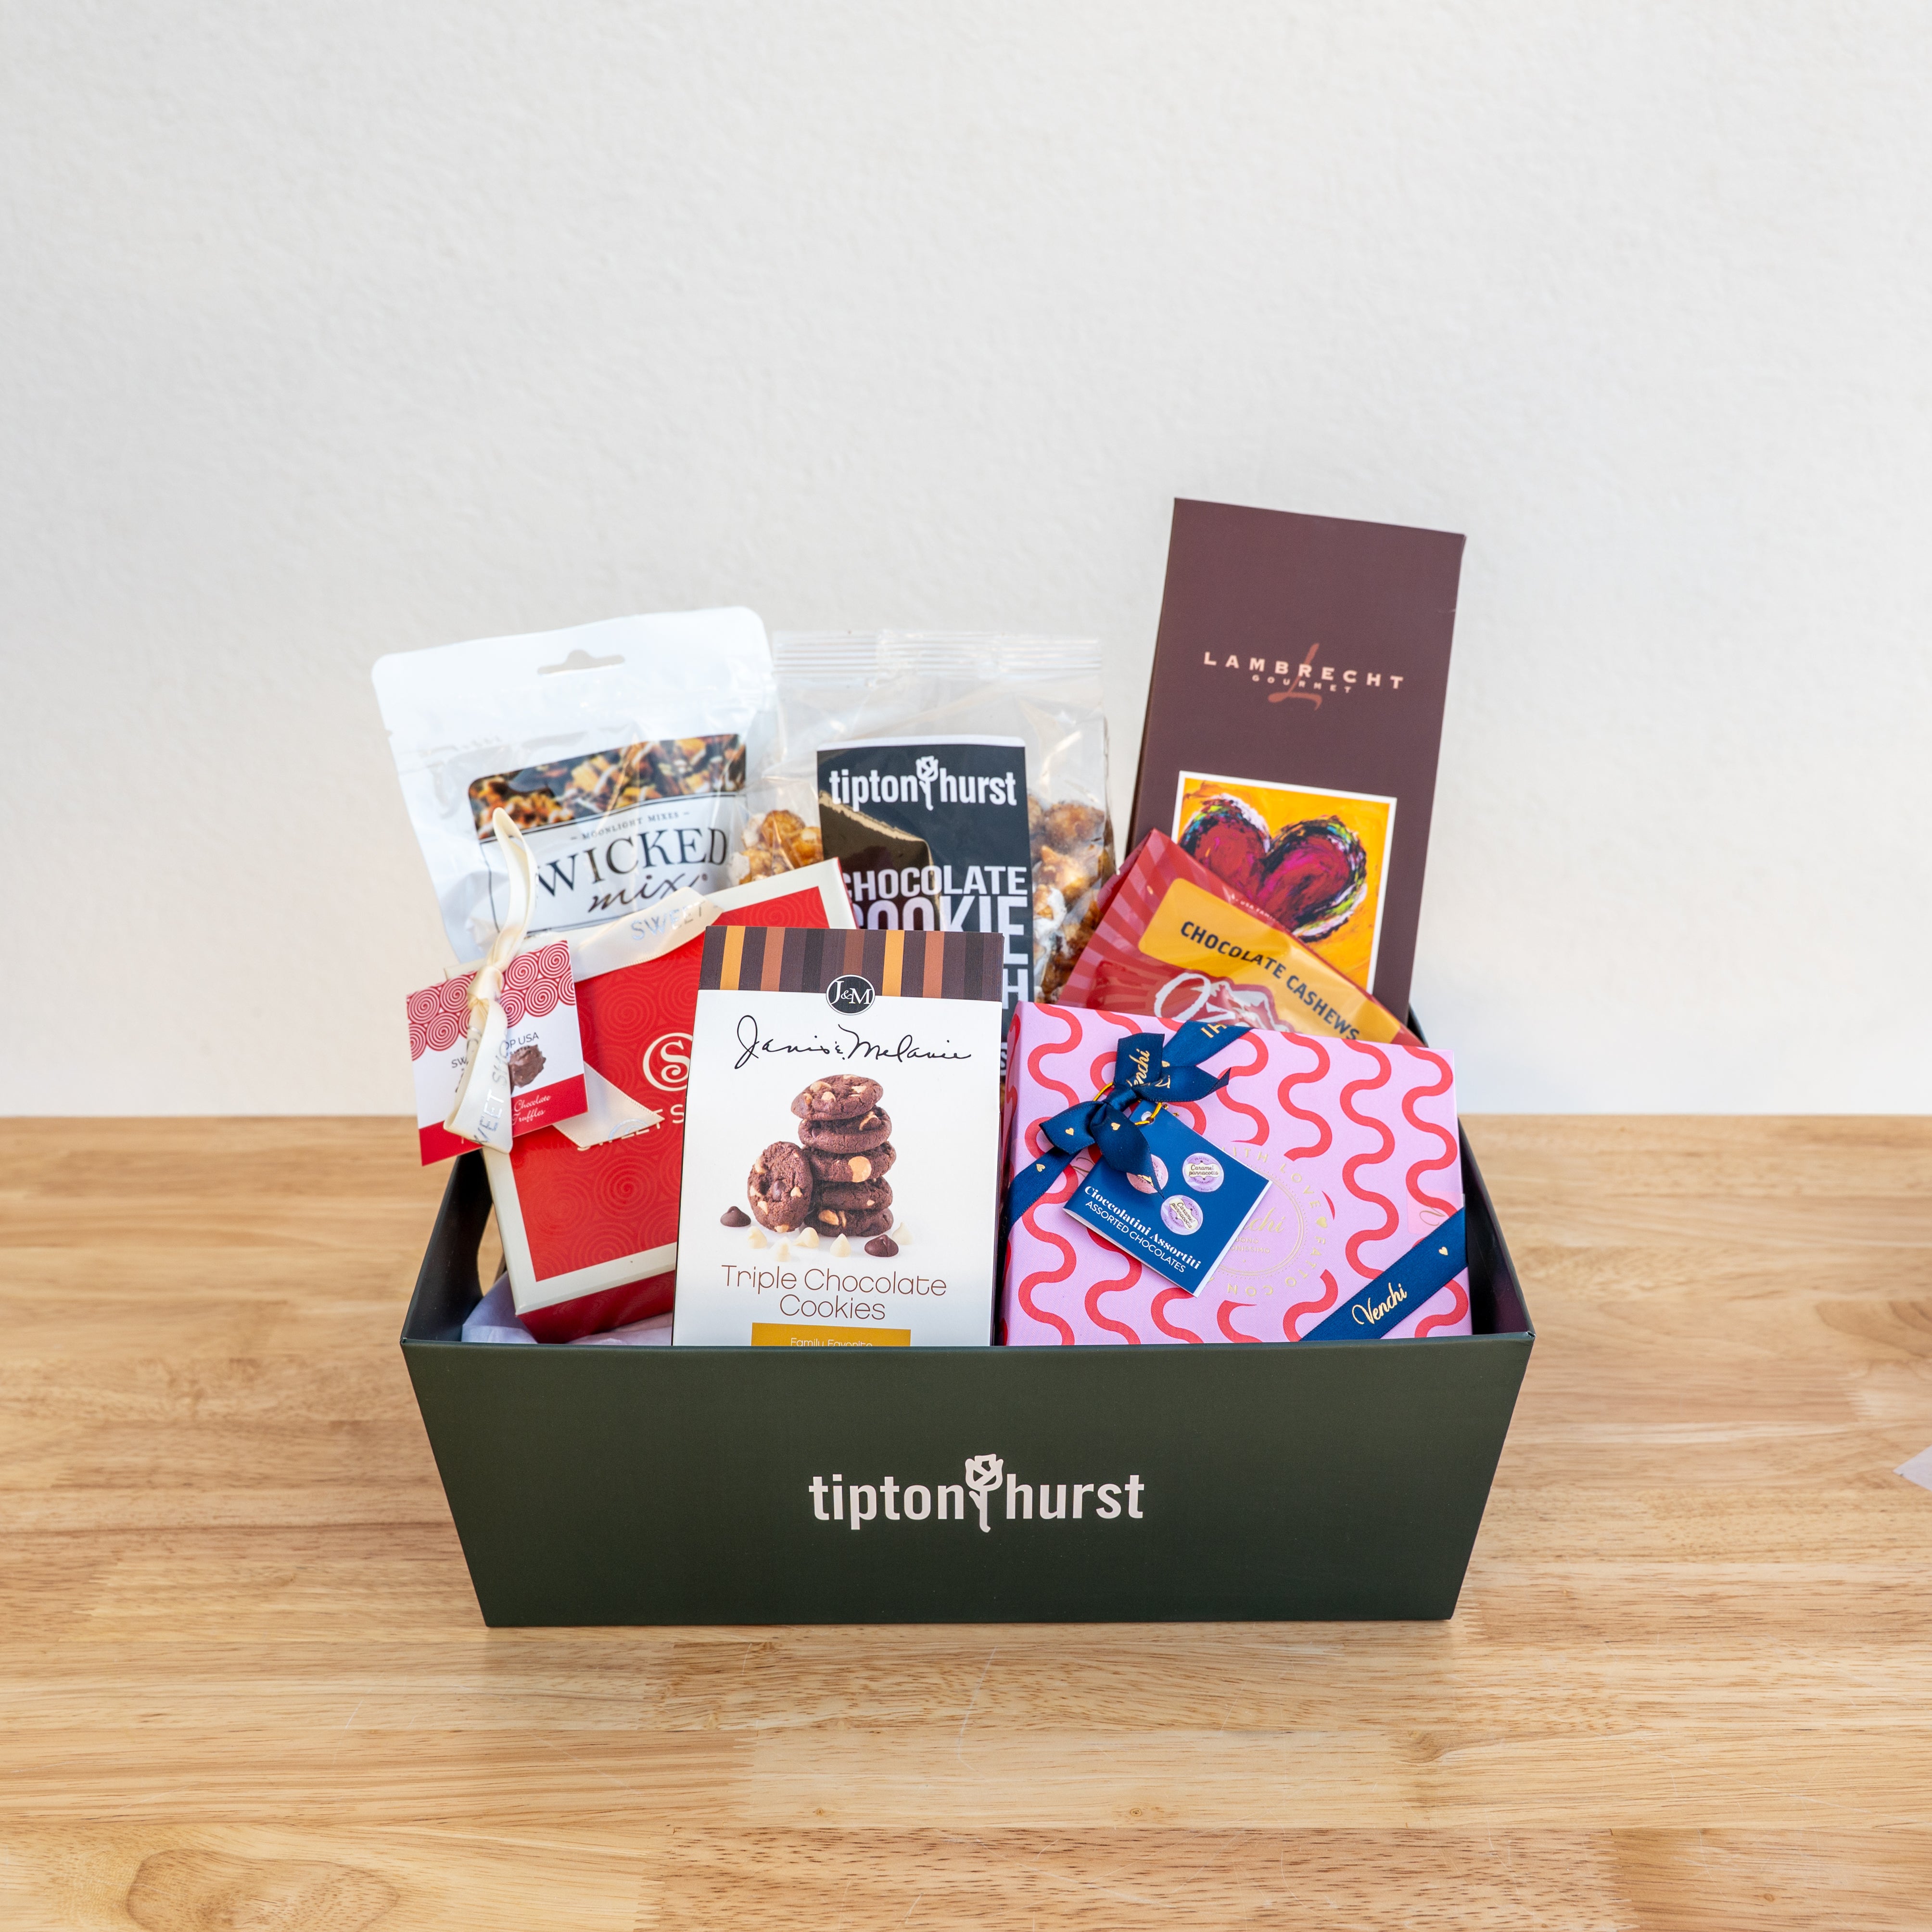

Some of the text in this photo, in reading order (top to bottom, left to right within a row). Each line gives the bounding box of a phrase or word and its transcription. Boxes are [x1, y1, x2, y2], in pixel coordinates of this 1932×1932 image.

[1204, 651, 1403, 689] LAMBRECHT
[1252, 674, 1351, 693] GOURMET
[829, 768, 1017, 812] tipton hurst
[582, 812, 679, 839] MOONLIGHT MIXES
[537, 827, 727, 897] WICKED
[630, 901, 705, 940] SWEET
[1180, 921, 1360, 1040] CHOCOLATE CASHEWS
[519, 1032, 539, 1045] USA
[735, 1015, 830, 1069] Janis
[838, 1024, 971, 1062] Melanie
[512, 1107, 545, 1125] Truffles
[514, 1095, 551, 1112] Chocolate
[1222, 1146, 1268, 1162] ITH
[1279, 1163, 1321, 1208] LOVE
[1084, 1186, 1201, 1270] Cioccolatini Assortiti
[1085, 1201, 1186, 1272] ASSORTED CHOCOLATES
[1243, 1207, 1285, 1233] chi
[722, 1265, 946, 1296] Triple Chocolate
[780, 1294, 885, 1320] Cookies
[1352, 1282, 1407, 1324] Venchi
[809, 1473, 1144, 1530] tipton hurst
